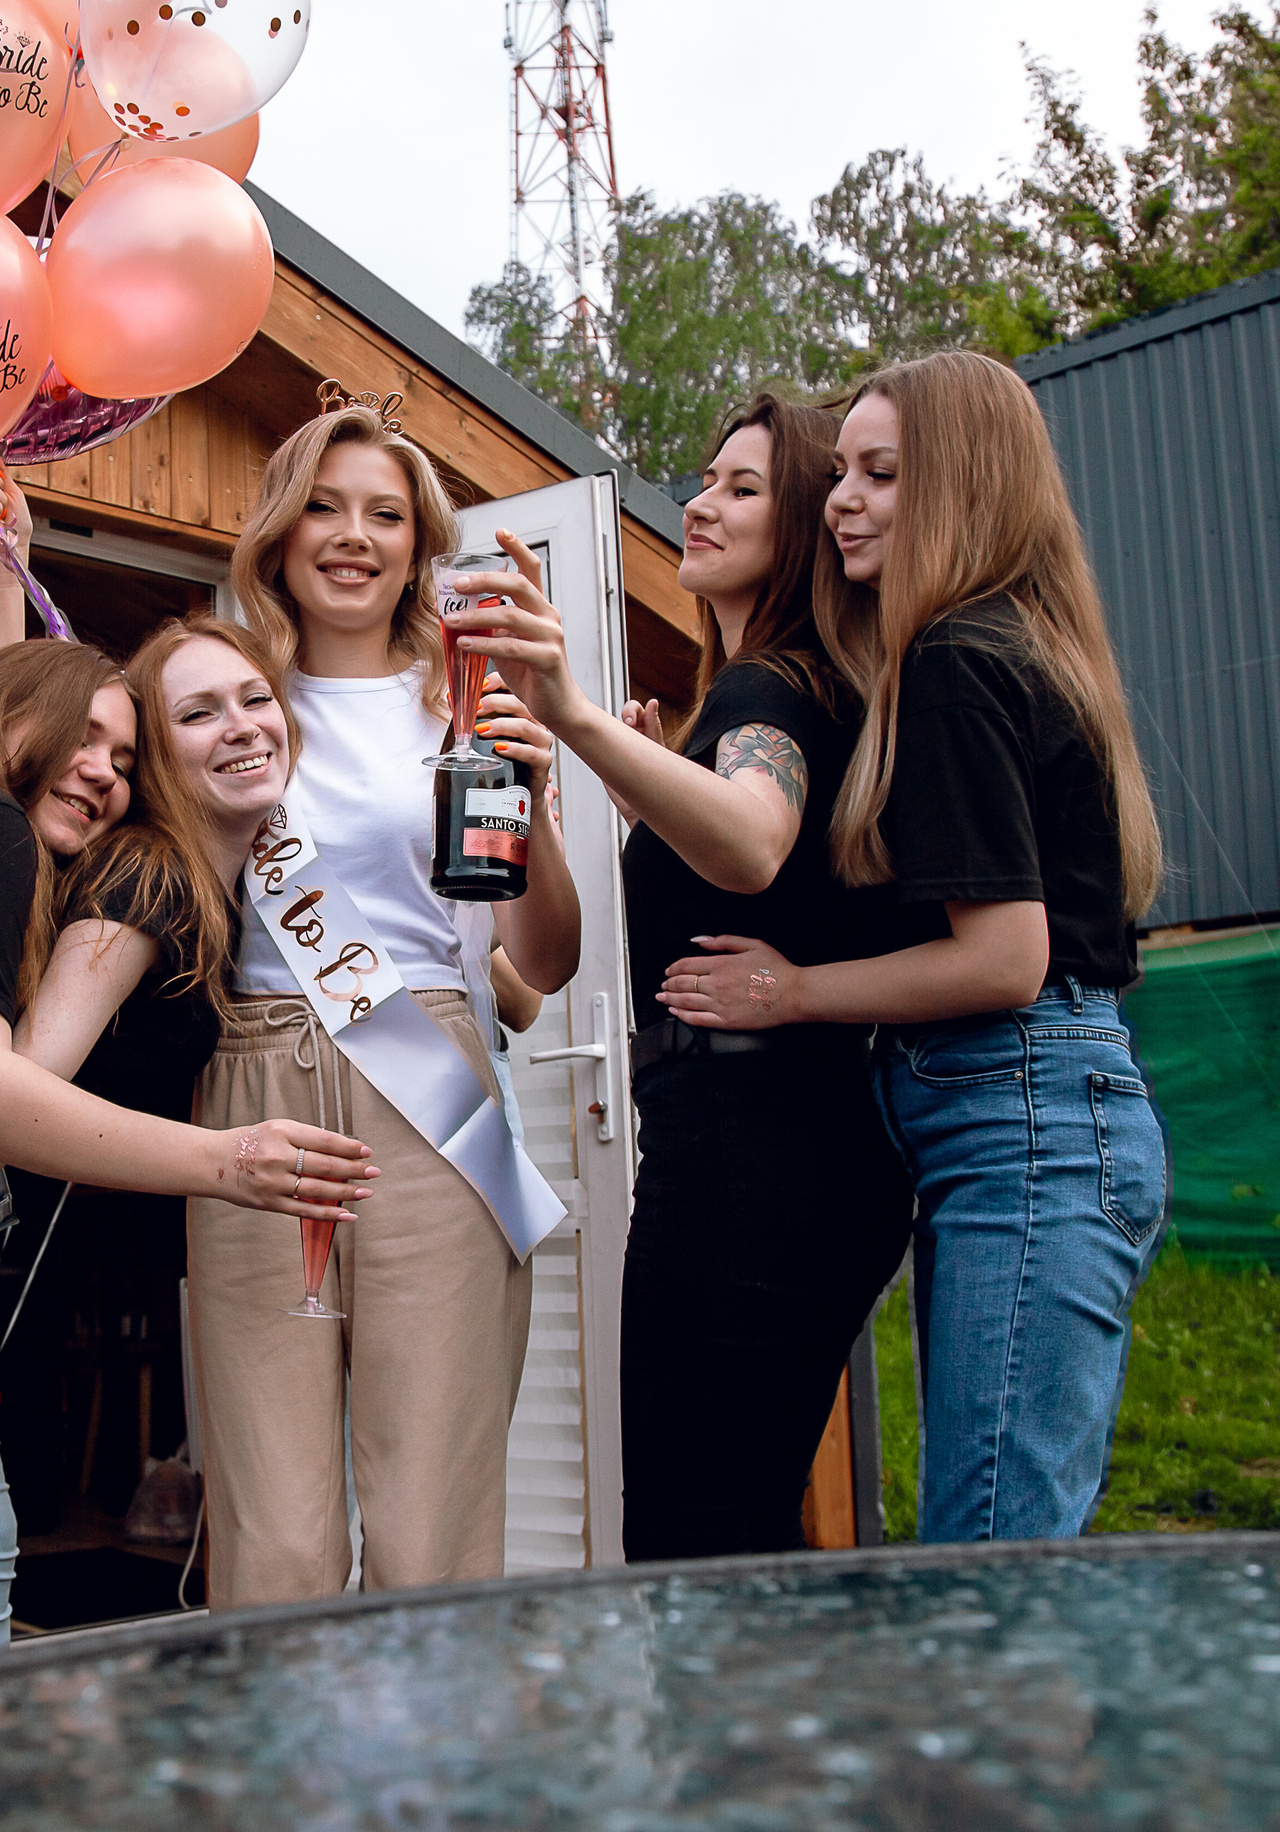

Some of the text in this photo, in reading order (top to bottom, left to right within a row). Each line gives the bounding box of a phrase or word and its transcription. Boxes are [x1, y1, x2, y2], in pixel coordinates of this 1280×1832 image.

[15, 81, 48, 118] Be
[481, 817, 516, 831] SANTO
[280, 886, 324, 953] to
[314, 943, 379, 1022] Be
